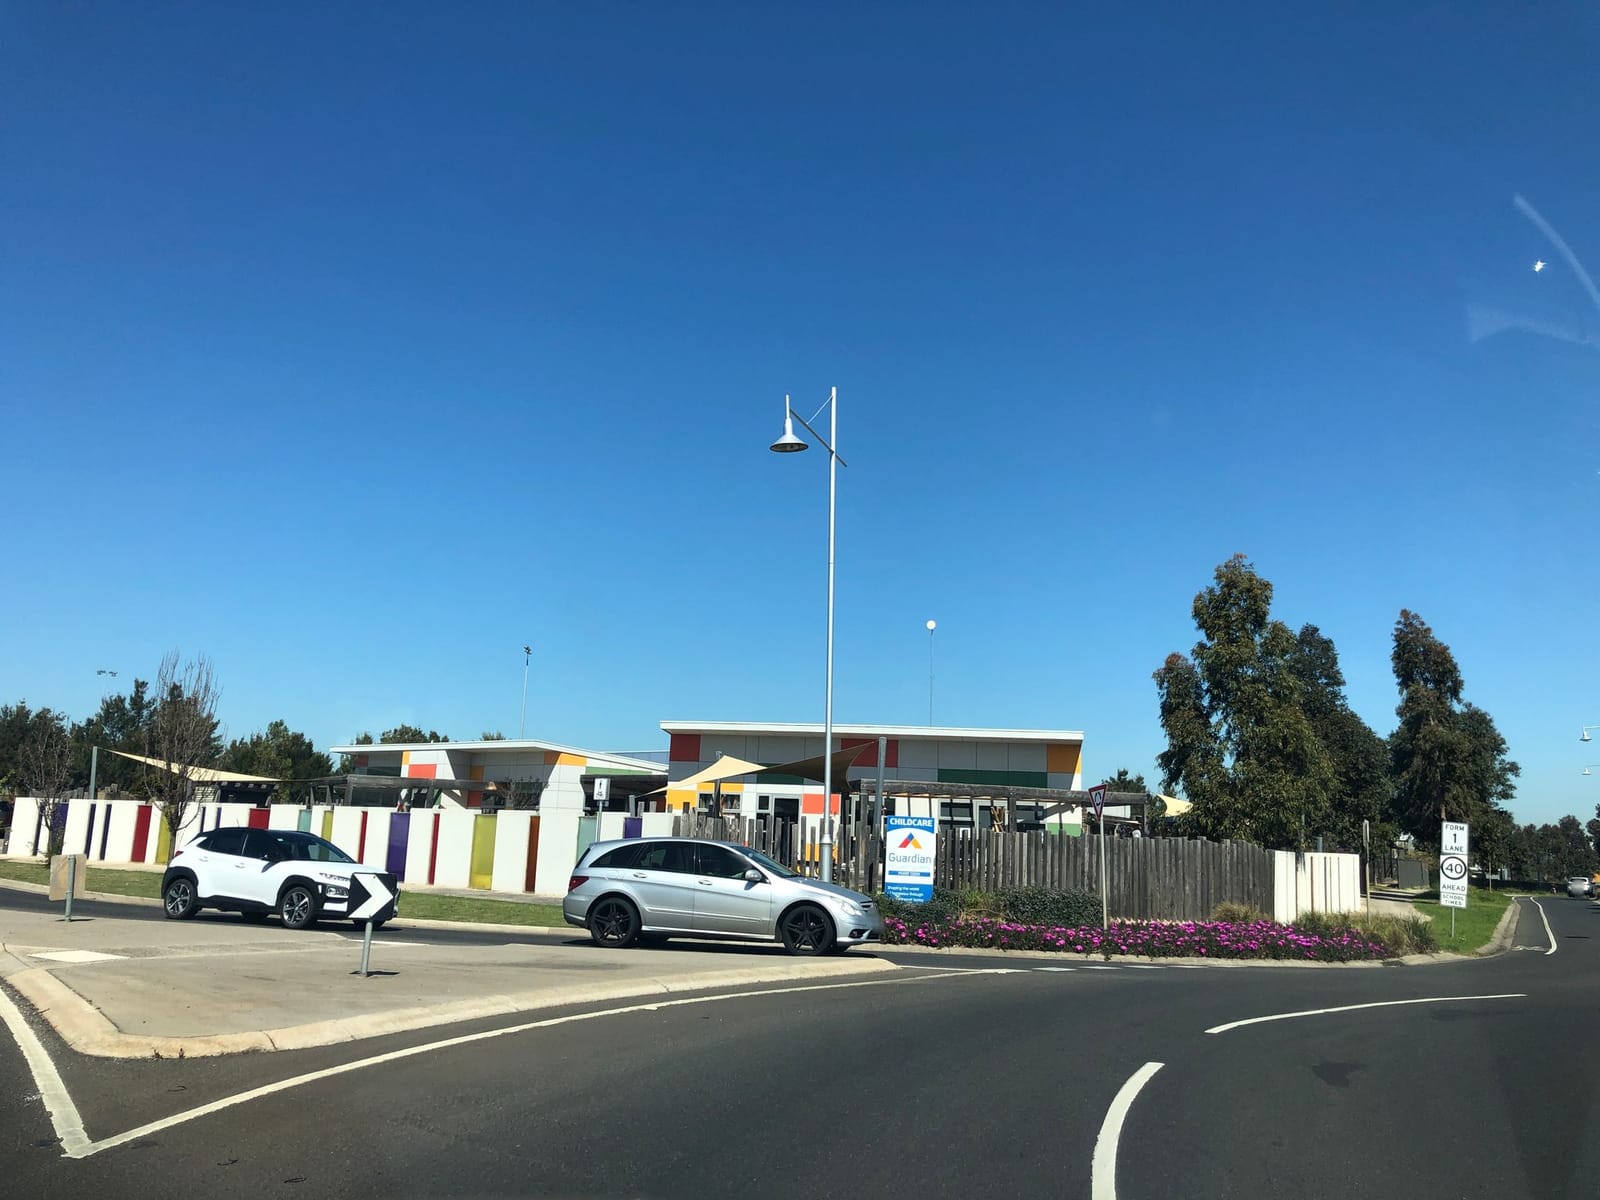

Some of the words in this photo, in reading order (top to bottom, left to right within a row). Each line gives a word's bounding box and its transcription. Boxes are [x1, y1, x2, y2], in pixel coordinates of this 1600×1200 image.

[889, 817, 933, 827] CHILDCARE
[1445, 824, 1465, 832] FORM
[1452, 833, 1457, 844] 1
[888, 852, 932, 864] Guardian
[1445, 863, 1463, 874] 40
[1442, 883, 1466, 892] AHEAD
